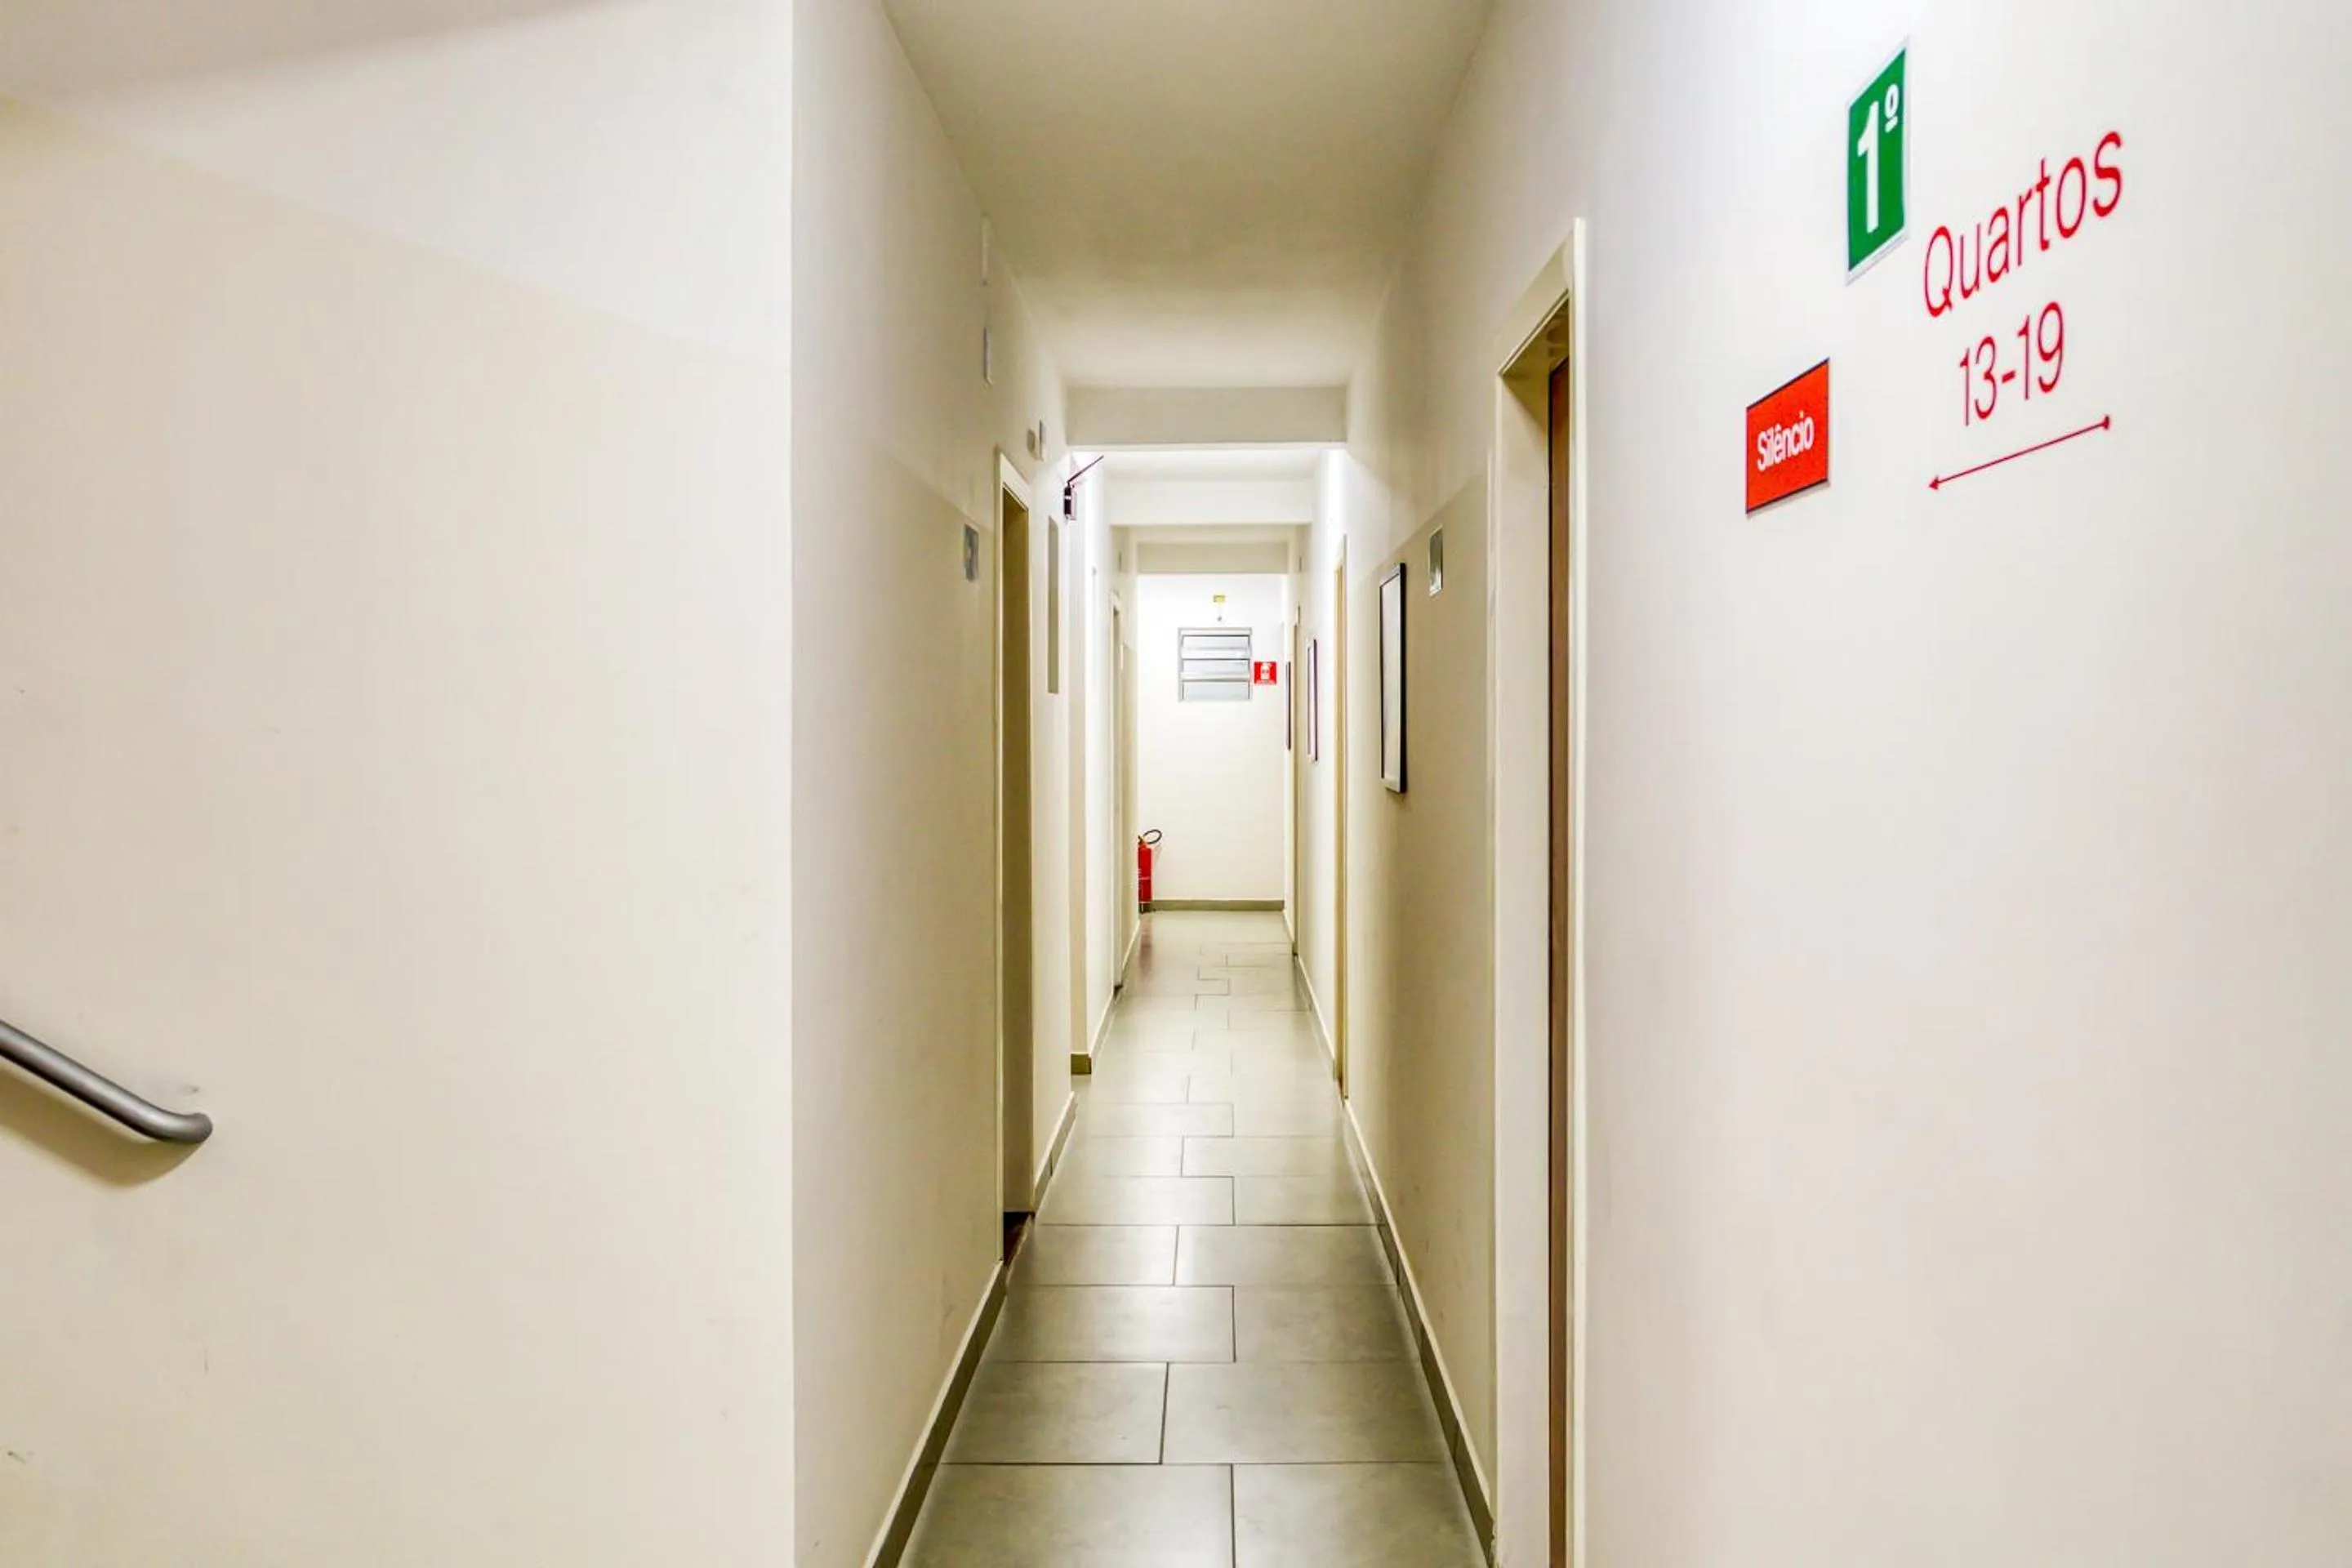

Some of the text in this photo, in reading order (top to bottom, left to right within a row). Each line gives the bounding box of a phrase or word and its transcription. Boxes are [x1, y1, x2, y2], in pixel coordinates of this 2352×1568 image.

[1857, 84, 1899, 234] 1º
[1924, 131, 2123, 318] Quartos
[1959, 301, 2065, 426] 13-19
[1757, 410, 1815, 471] Silêncio
